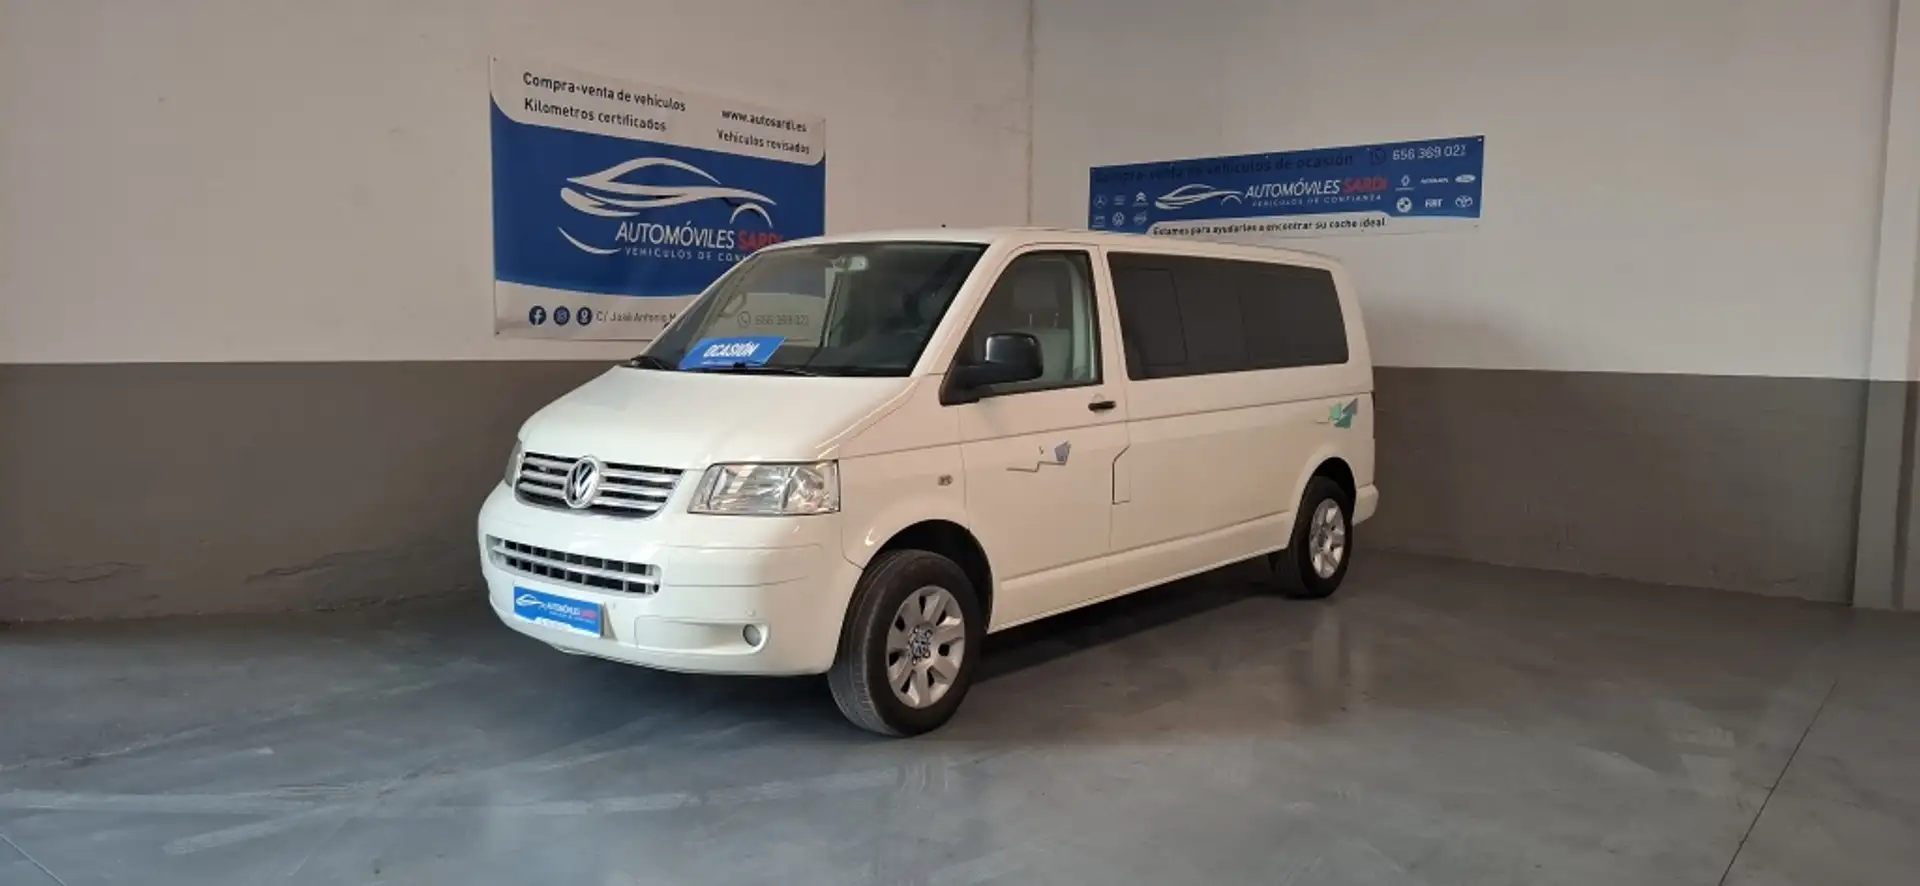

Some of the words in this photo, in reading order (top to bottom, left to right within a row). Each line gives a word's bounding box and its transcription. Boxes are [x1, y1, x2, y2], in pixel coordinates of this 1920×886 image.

[523, 71, 614, 100] Compra-venta
[617, 88, 631, 102] de
[525, 97, 594, 121] Kilometros
[598, 111, 667, 132] certificados
[721, 110, 807, 132] www.autosardi.es
[766, 139, 810, 155] revisados
[1392, 147, 1416, 161] 656
[1418, 145, 1442, 160] 369
[1275, 156, 1293, 171] de
[1297, 153, 1352, 169] ocasión
[1244, 176, 1341, 199] AUTOMÓVILES
[1307, 196, 1319, 205] DE
[1323, 193, 1382, 204] CONFIANZA
[615, 219, 735, 250] AUTOMÓVILES
[1191, 225, 1210, 236] para
[1266, 222, 1312, 232] encontrar
[1315, 220, 1327, 230] su
[1329, 219, 1357, 229] coche
[1360, 217, 1385, 228] ideal
[697, 251, 712, 261] DE
